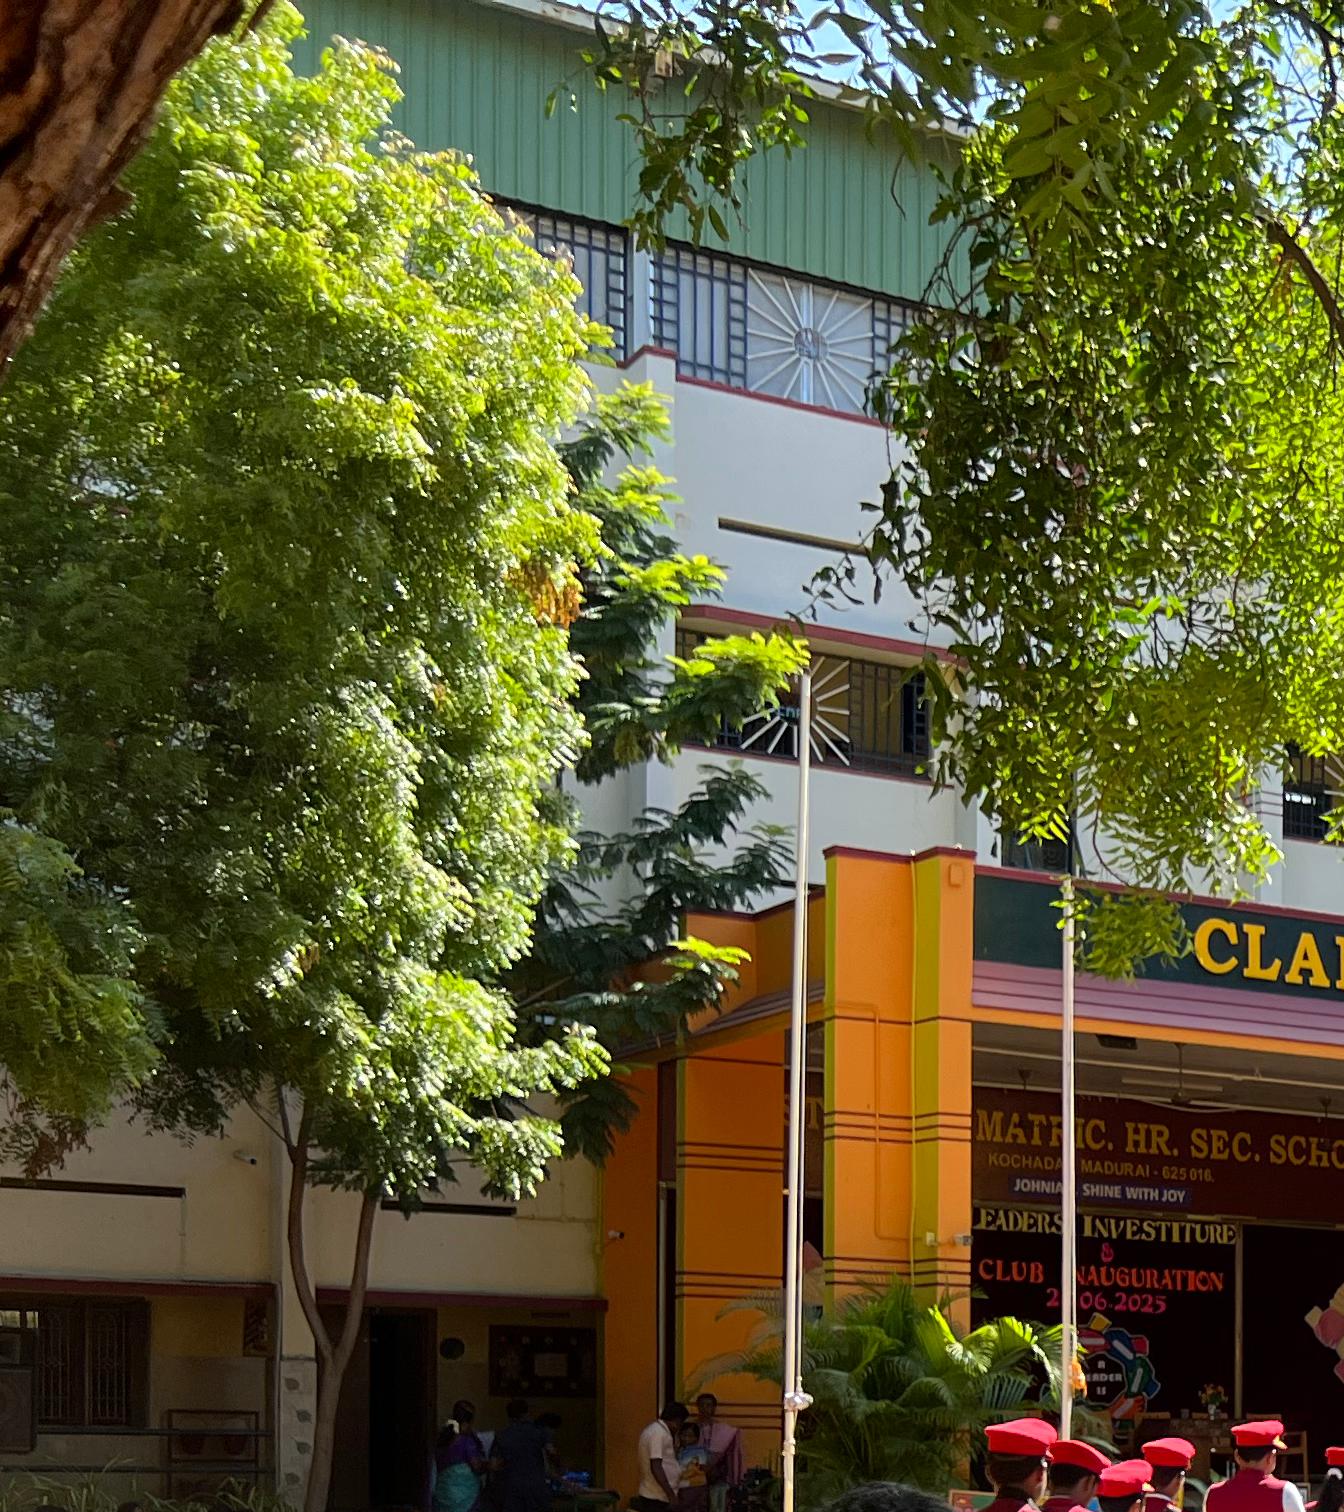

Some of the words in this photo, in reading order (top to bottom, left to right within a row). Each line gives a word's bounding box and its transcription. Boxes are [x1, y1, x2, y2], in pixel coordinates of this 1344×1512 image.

[1125, 1121, 1179, 1157] HR.
[1190, 1127, 1260, 1163] SEC.
[988, 1152, 1065, 1171] KOCHADA
[1081, 1159, 1150, 1178] MADURAI
[1162, 1166, 1187, 1181] 625
[1082, 1183, 1122, 1199] SHINE
[1125, 1186, 1160, 1201] WITH
[1161, 1188, 1186, 1203] JOY
[1083, 1215, 1238, 1245] INVESTITURE
[978, 1259, 1045, 1284] CLUB
[1076, 1264, 1224, 1292] NAUGURATION
[1086, 1373, 1123, 1382] EADER
